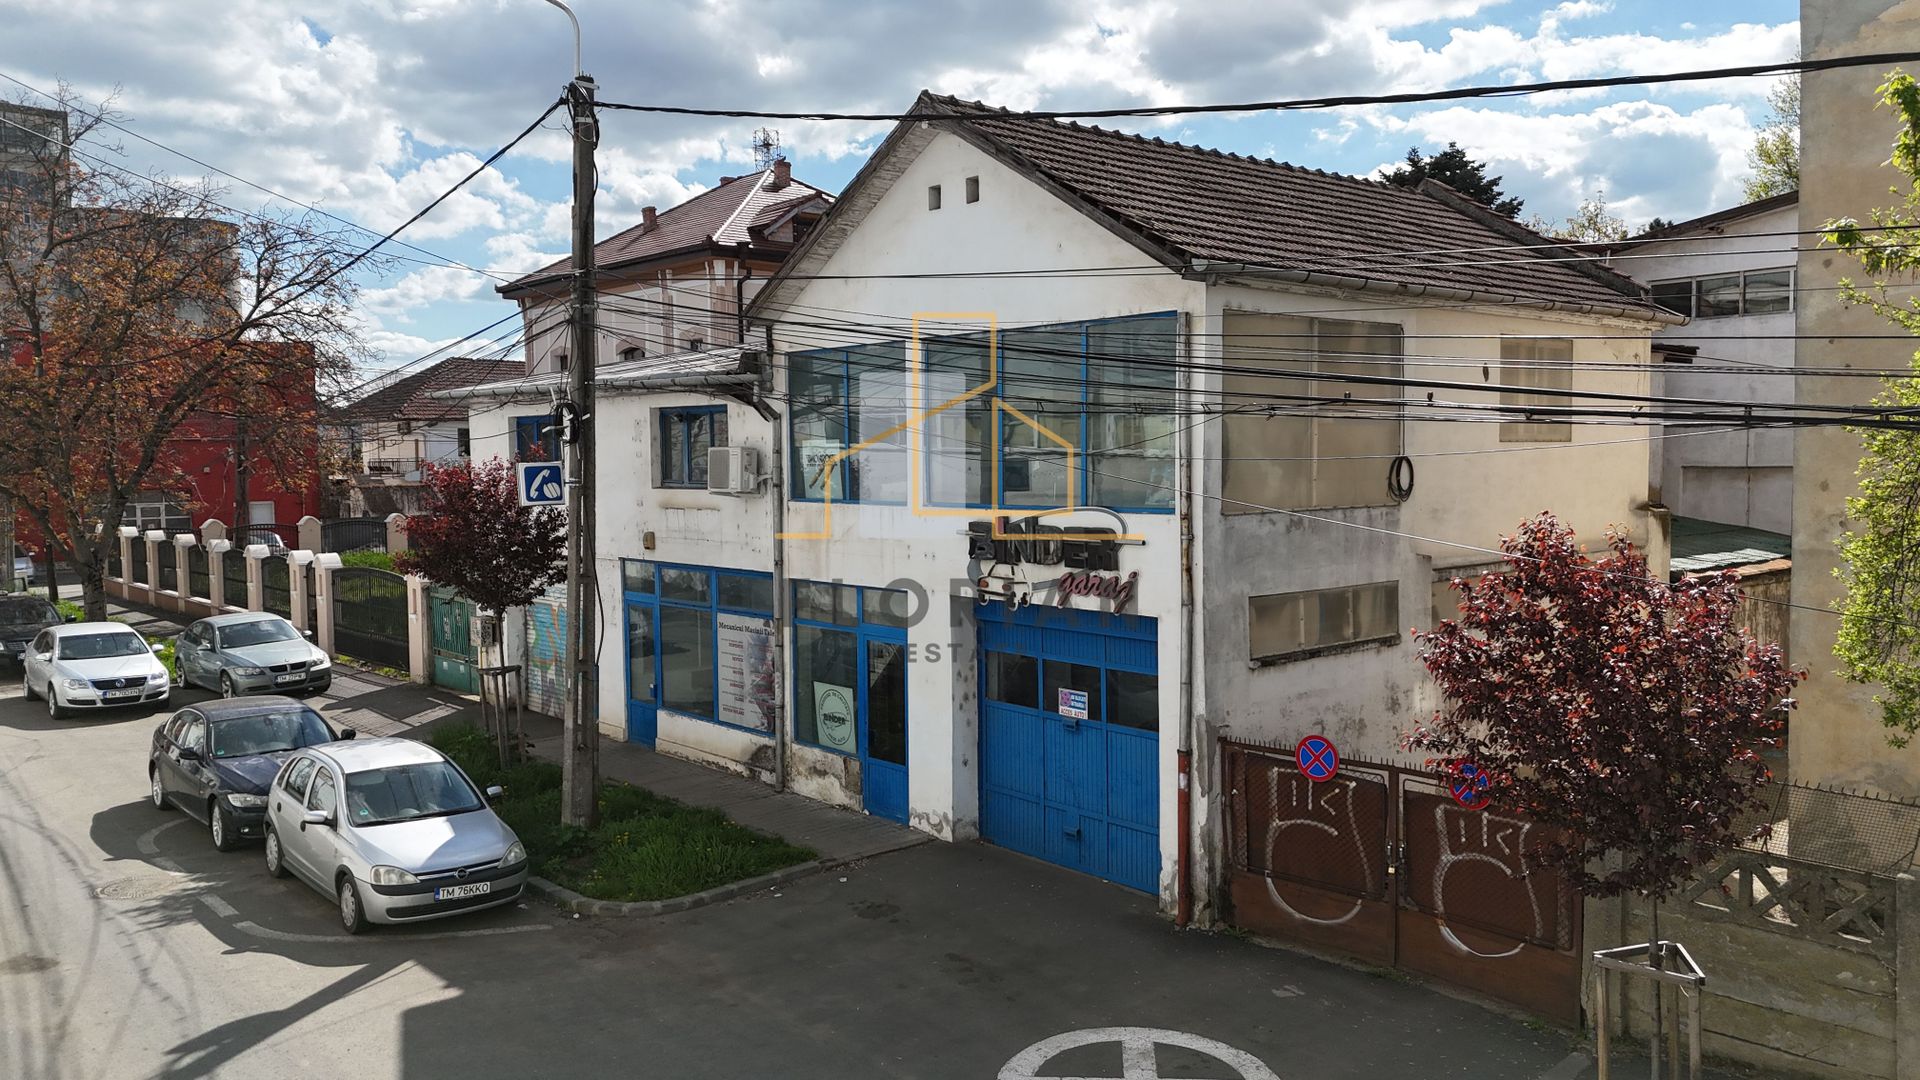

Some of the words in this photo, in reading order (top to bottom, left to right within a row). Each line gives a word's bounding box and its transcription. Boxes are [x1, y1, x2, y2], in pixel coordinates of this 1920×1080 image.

[1057, 571, 1139, 615] garaj
[441, 888, 455, 898] TM
[457, 884, 489, 895] 76KKO
